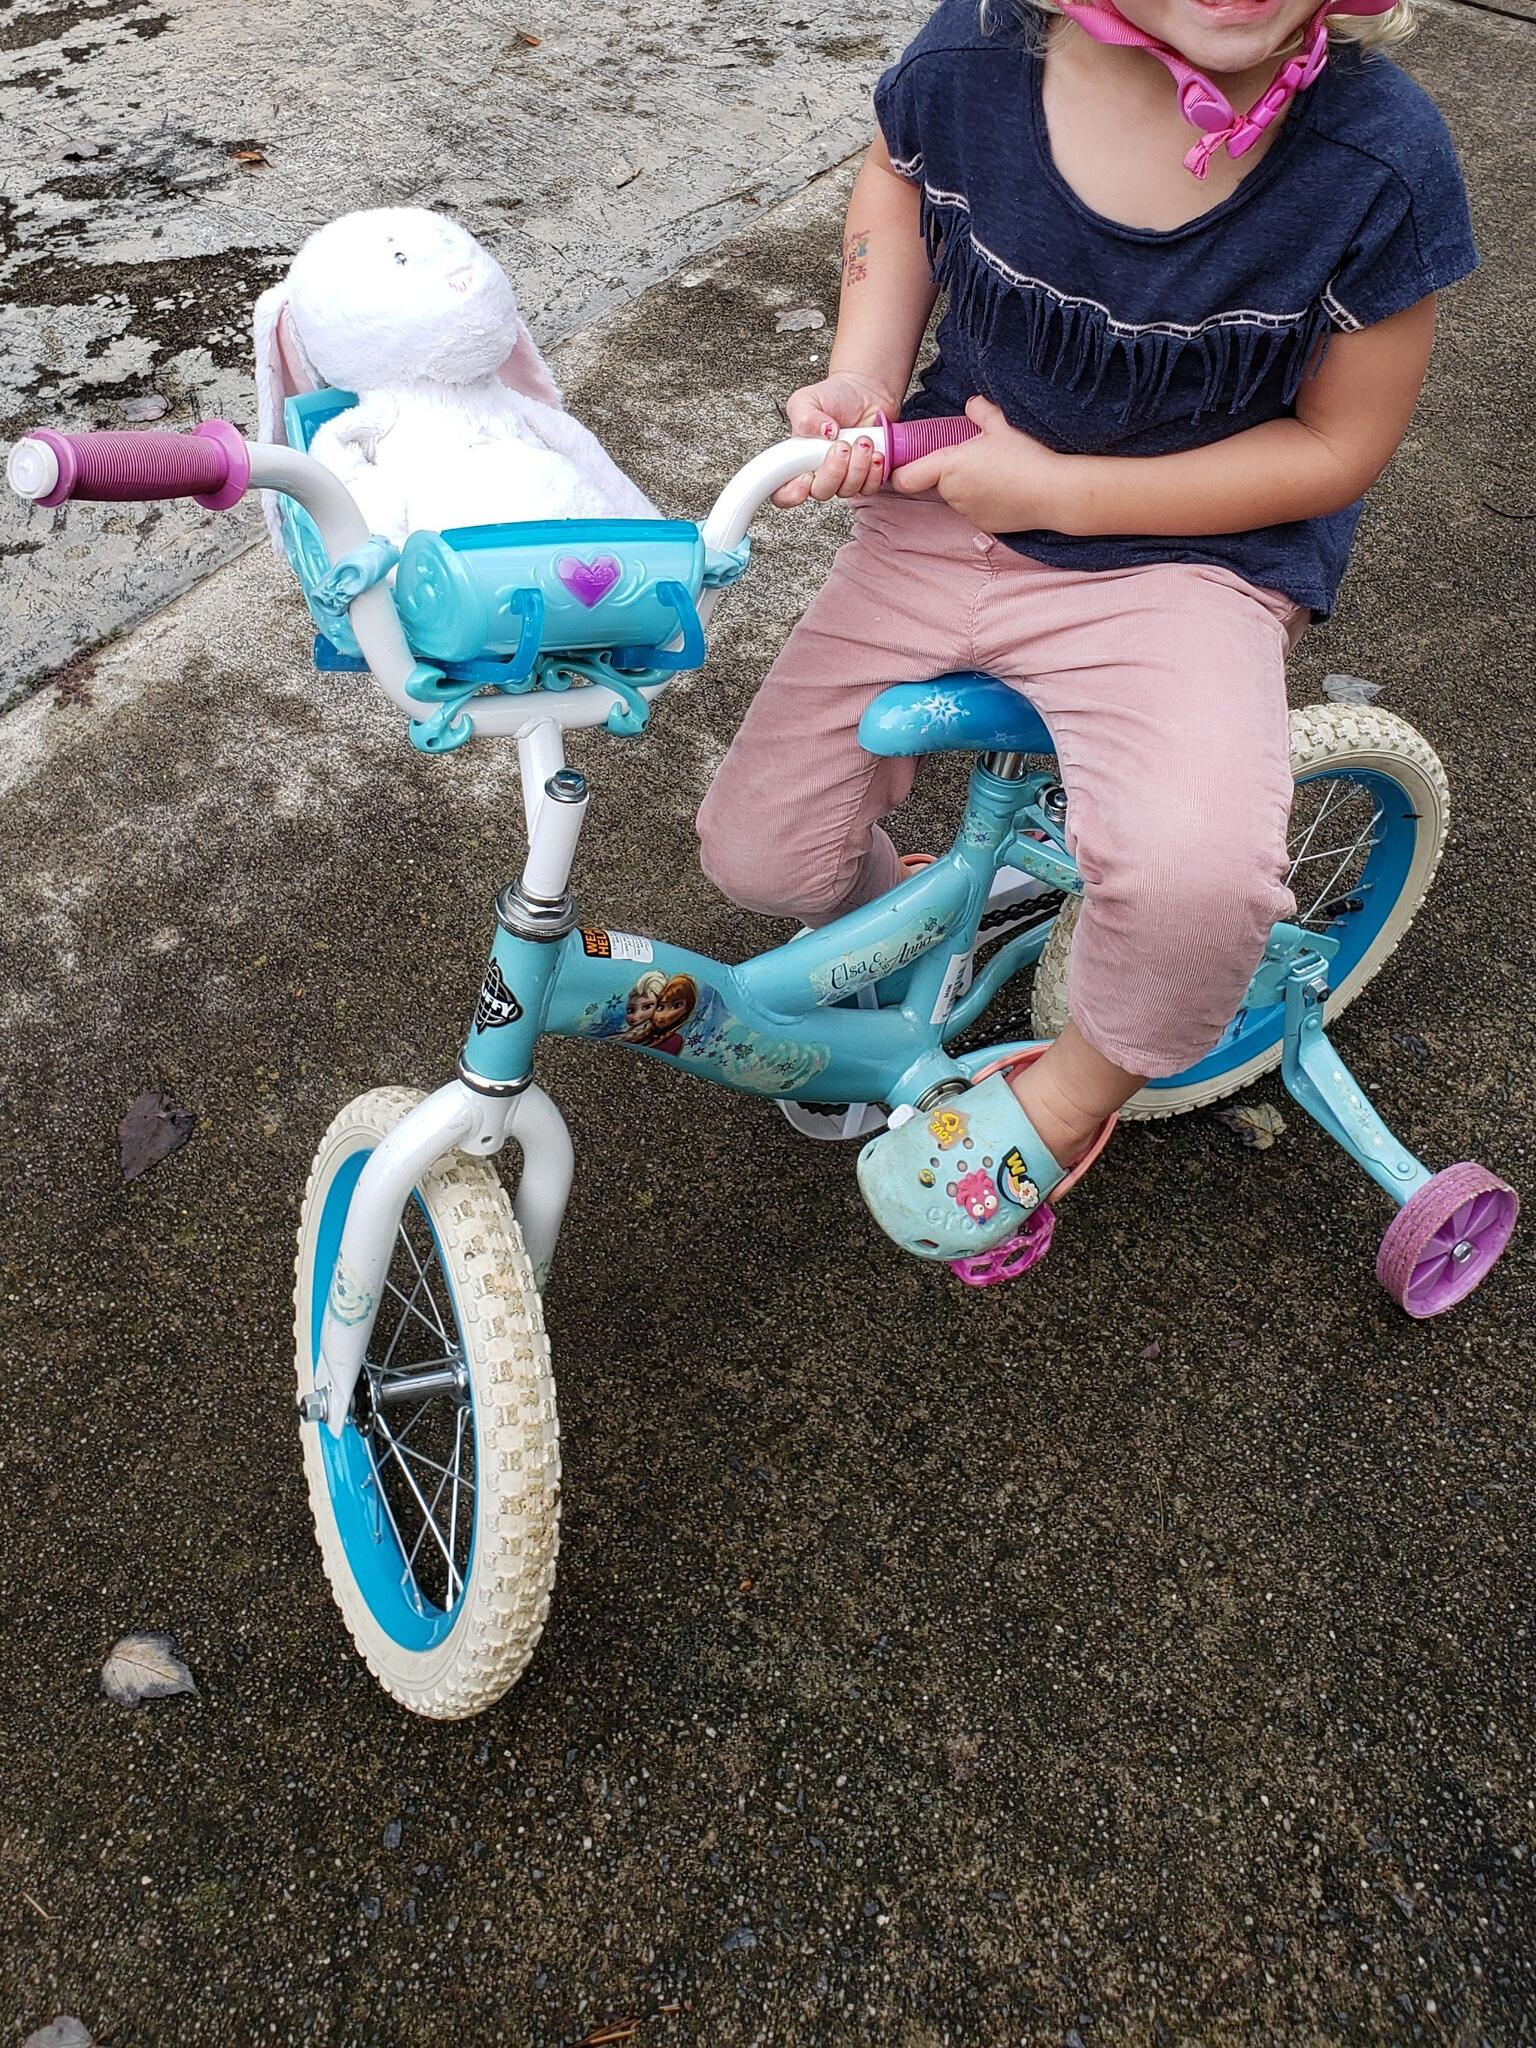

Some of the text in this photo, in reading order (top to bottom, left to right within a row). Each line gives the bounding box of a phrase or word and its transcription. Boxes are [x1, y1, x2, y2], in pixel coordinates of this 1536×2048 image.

[583, 928, 598, 954] WEA
[593, 928, 610, 956] HEL
[830, 962, 868, 991] Elsa
[887, 936, 933, 971] Anna
[481, 984, 516, 1018] UFFY
[930, 1120, 953, 1145] LOVE
[926, 1206, 1012, 1232] cros
